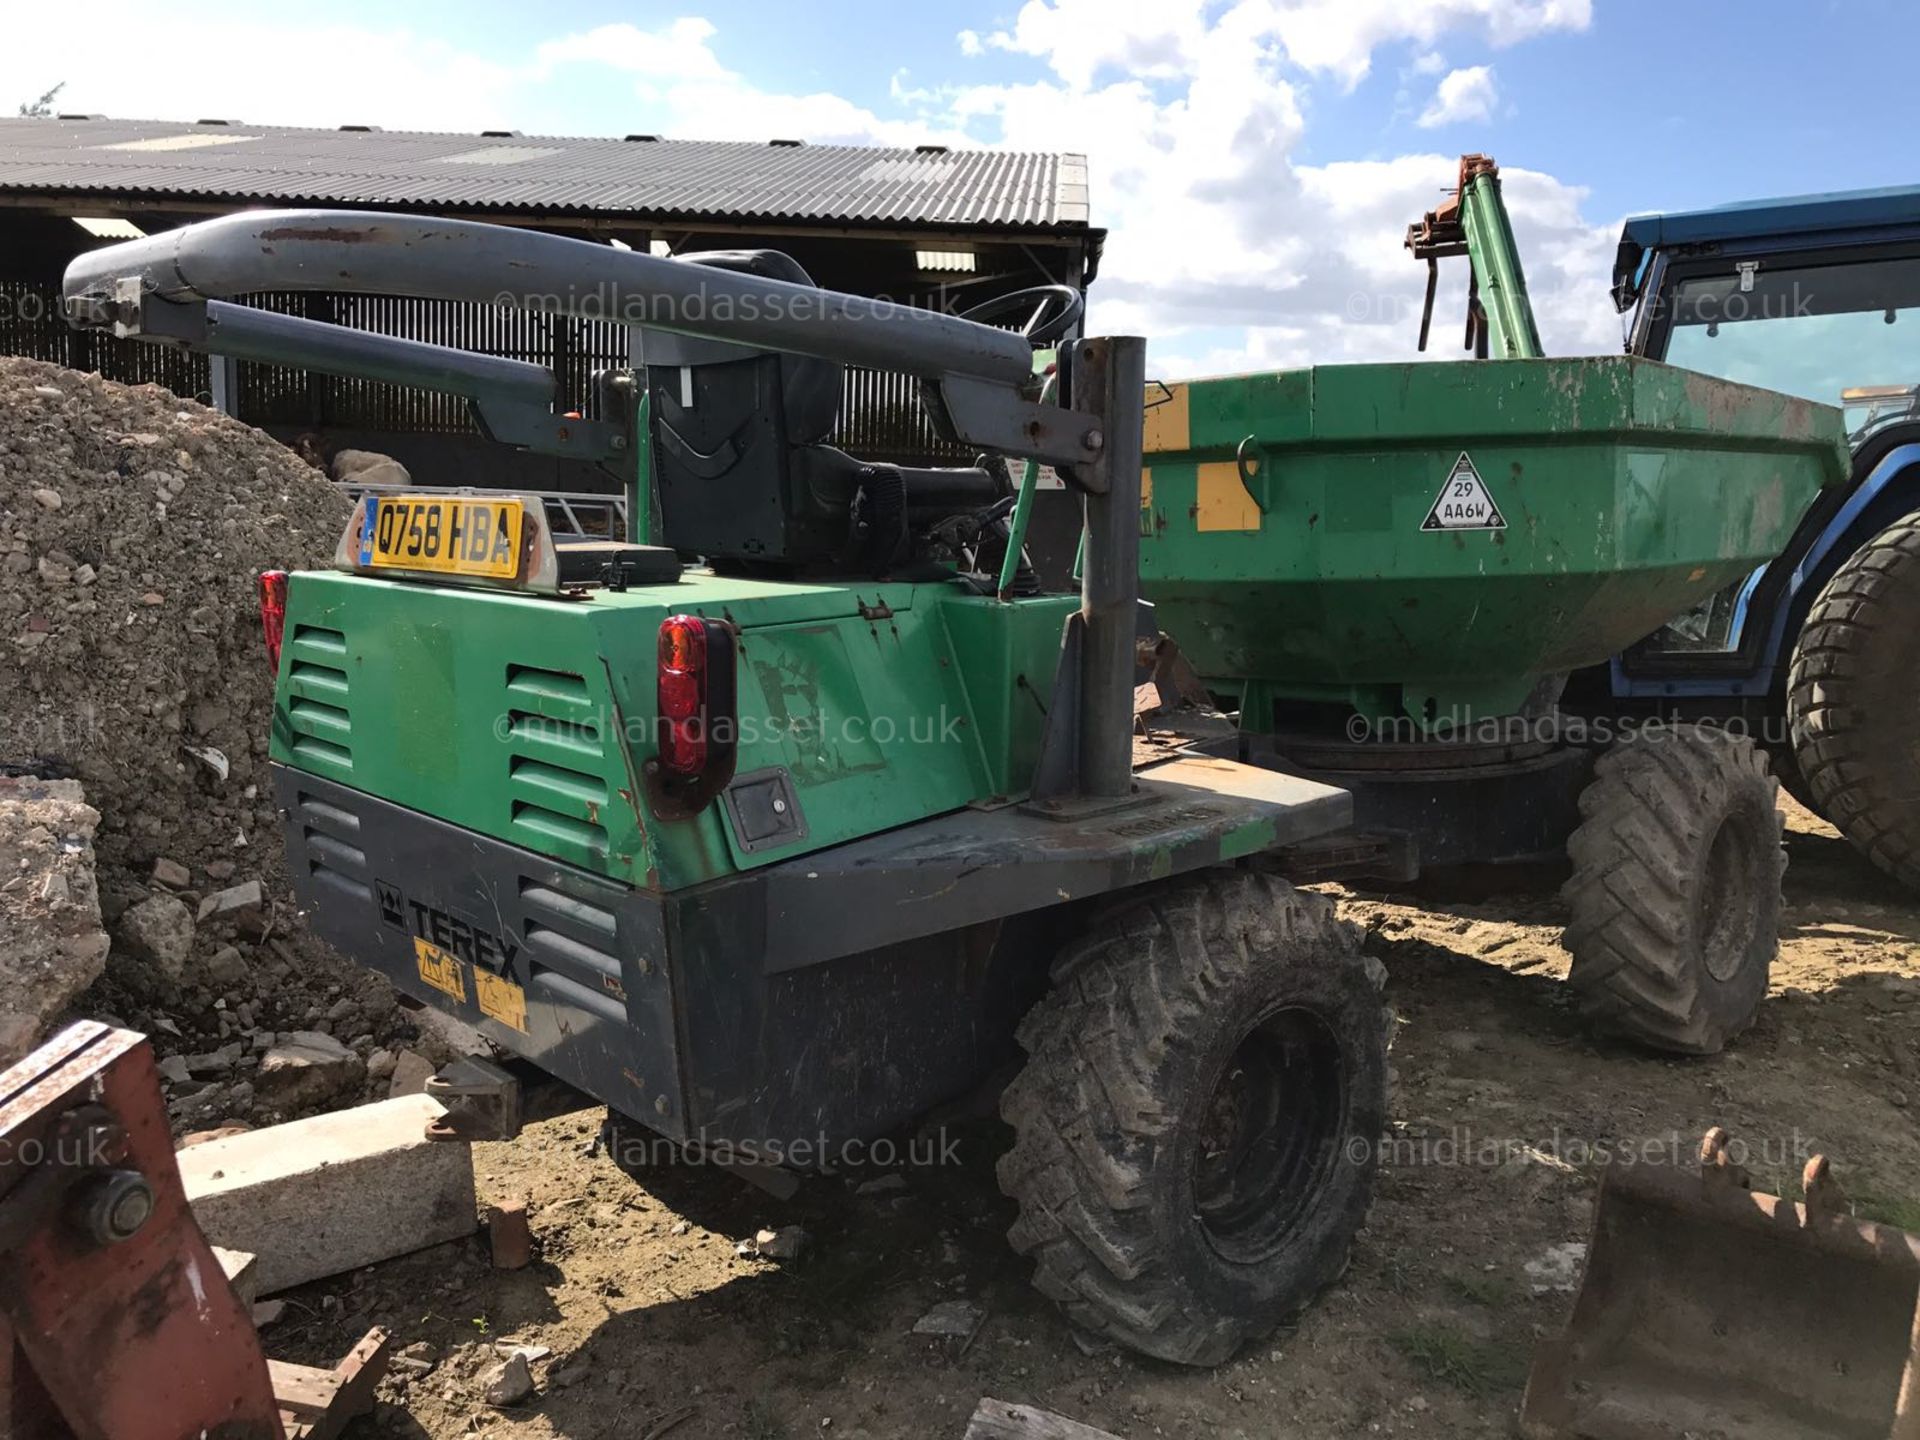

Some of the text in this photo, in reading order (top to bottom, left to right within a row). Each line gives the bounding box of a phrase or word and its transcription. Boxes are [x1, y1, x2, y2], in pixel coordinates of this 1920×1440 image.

[1454, 482, 1473, 497] 29
[1444, 502, 1485, 518] AA6W
[378, 504, 511, 564] Q758 HBA
[408, 898, 523, 987] TEREX
